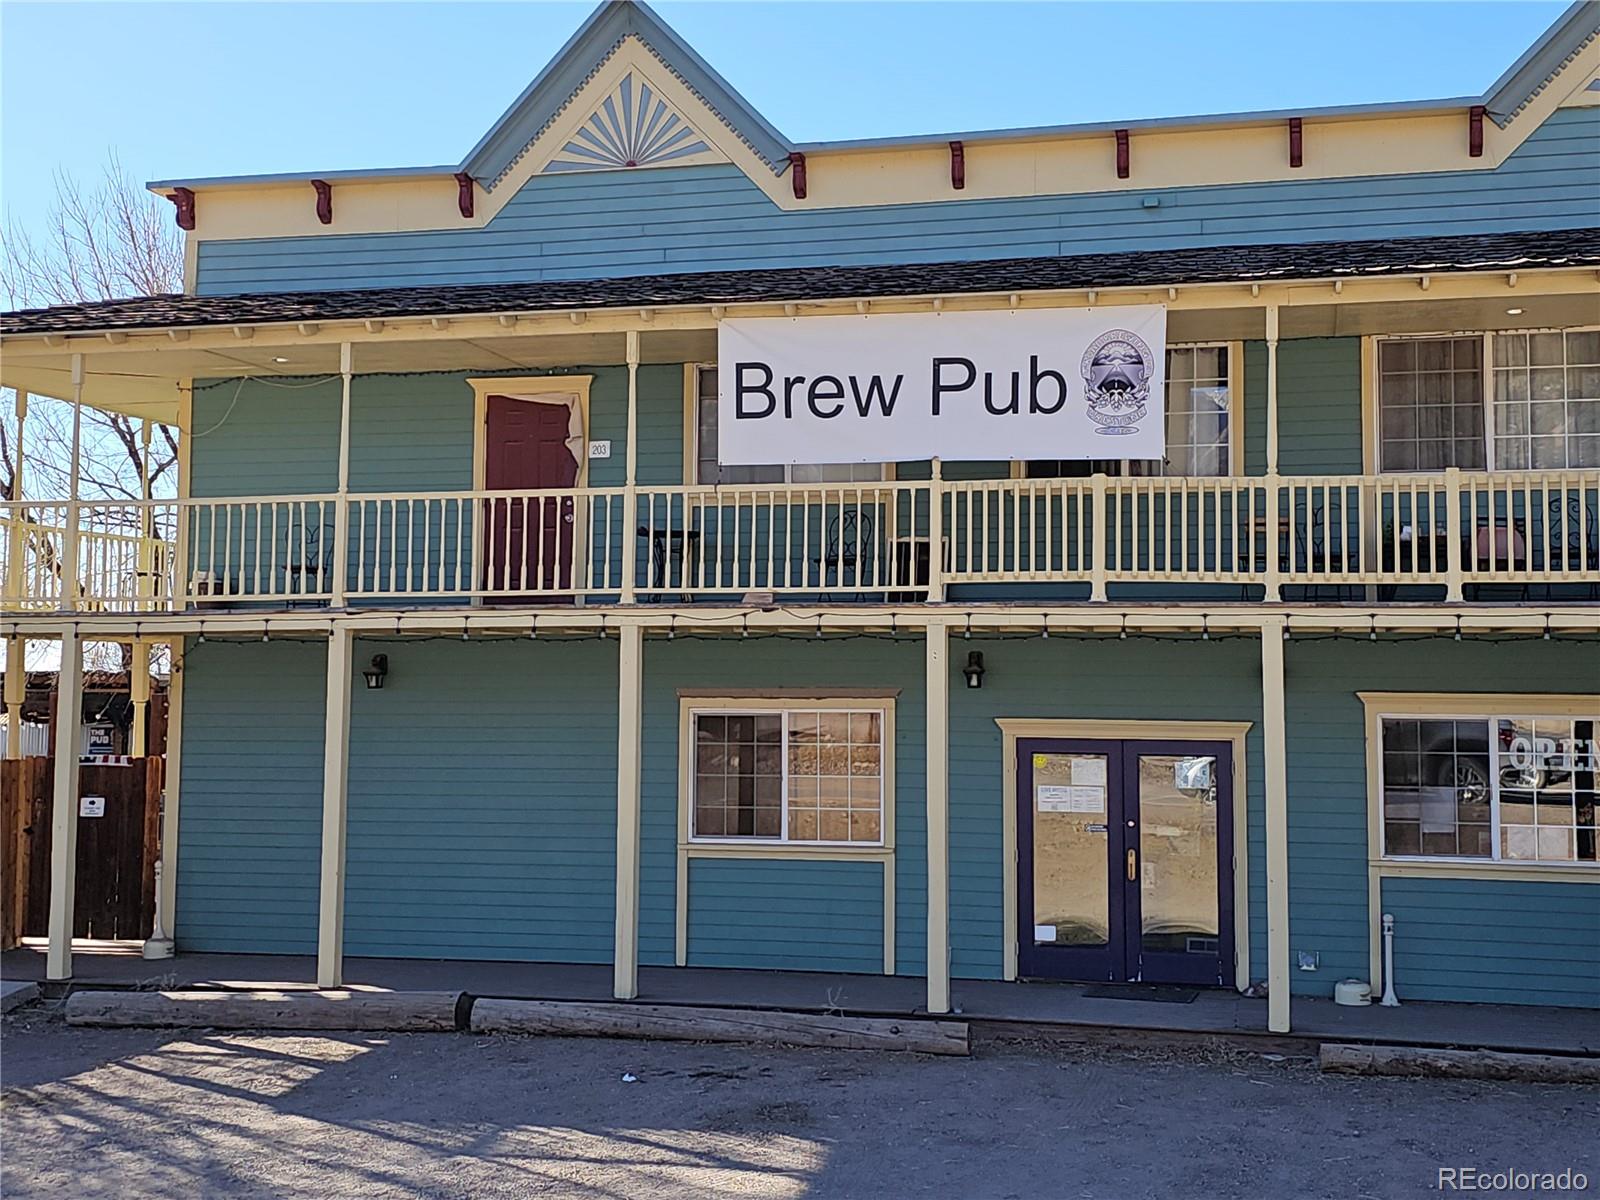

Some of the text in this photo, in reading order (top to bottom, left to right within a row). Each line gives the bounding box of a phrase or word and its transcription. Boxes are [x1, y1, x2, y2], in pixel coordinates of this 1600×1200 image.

[734, 362, 904, 420] Brew
[931, 355, 1068, 417] Pub
[592, 444, 607, 455] 203
